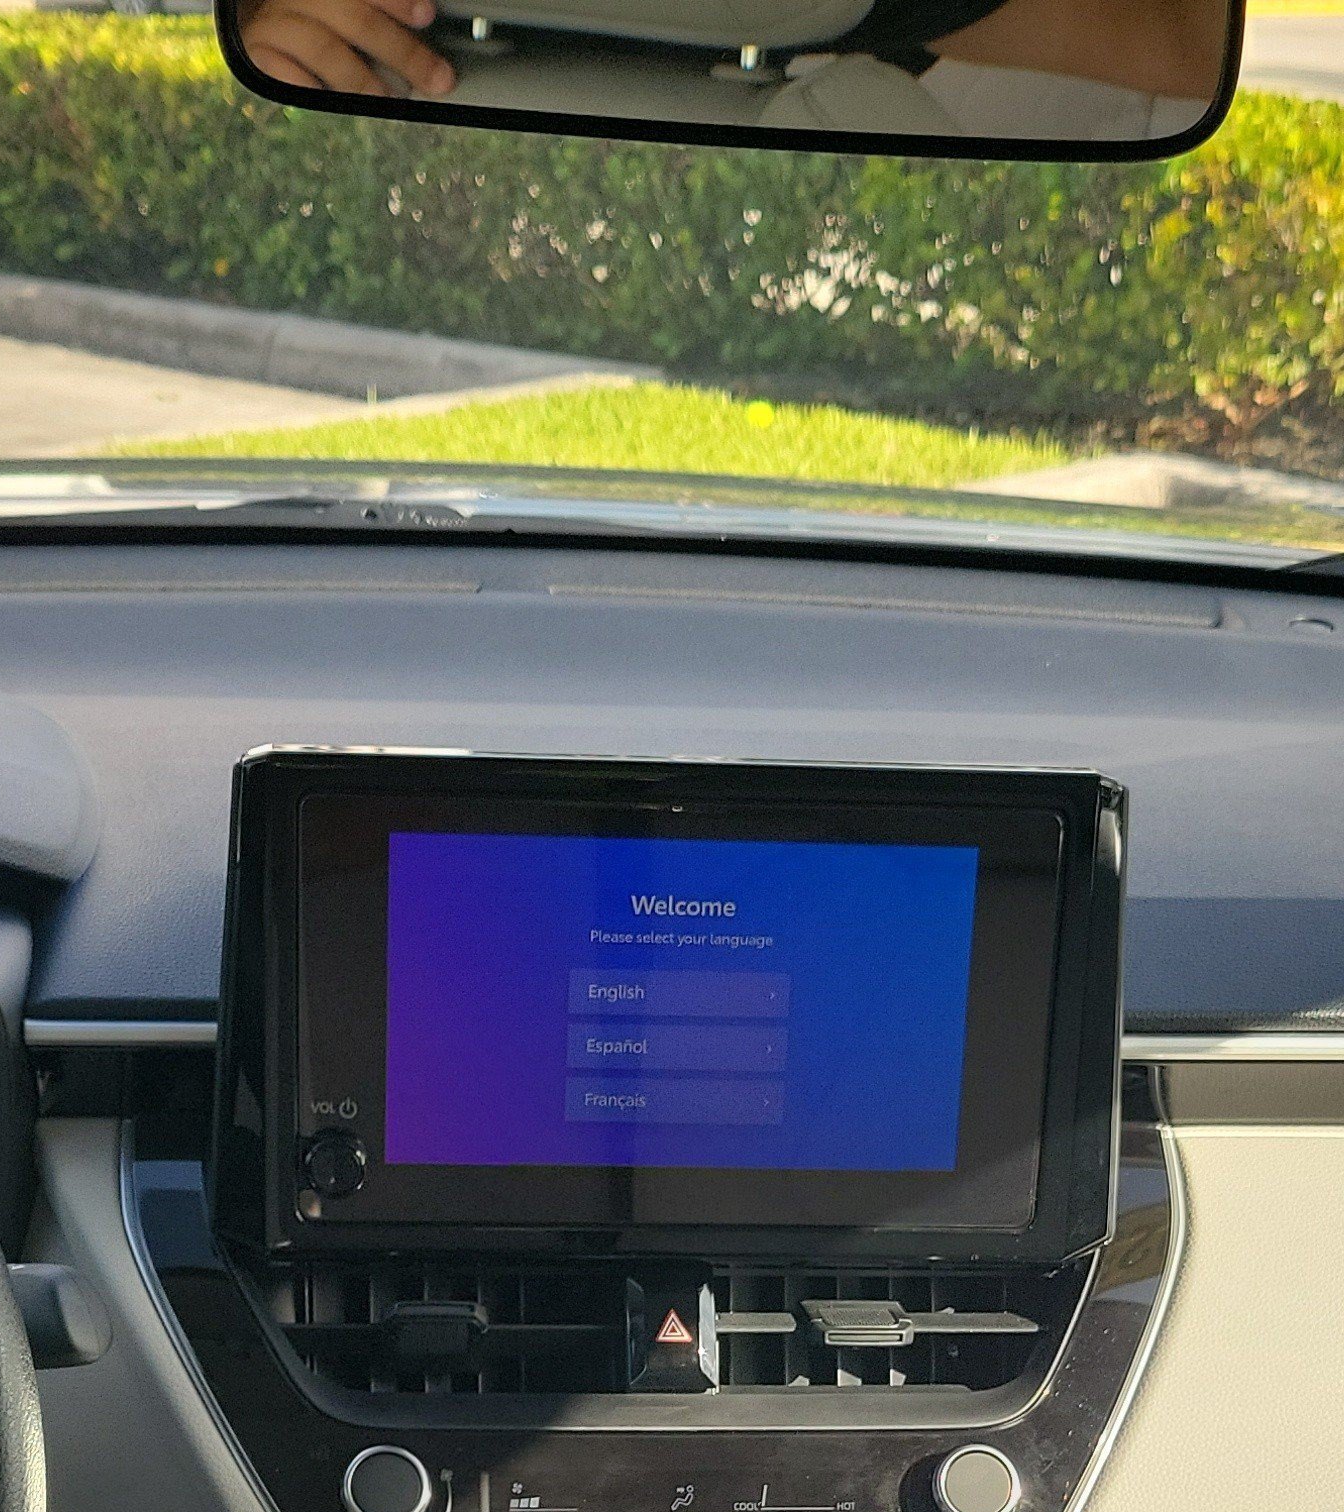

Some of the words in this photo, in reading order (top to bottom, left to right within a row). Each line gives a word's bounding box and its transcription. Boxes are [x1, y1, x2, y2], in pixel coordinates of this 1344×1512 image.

[630, 895, 737, 917] Welcome
[590, 929, 633, 944] Please
[636, 931, 674, 944] select
[677, 935, 707, 947] your
[710, 934, 773, 949] language
[588, 984, 645, 1002] English
[586, 1038, 648, 1056] Español
[311, 1101, 336, 1114] VOL
[584, 1093, 646, 1110] Français
[733, 1502, 759, 1511] COOL
[836, 1501, 855, 1511] HOT
